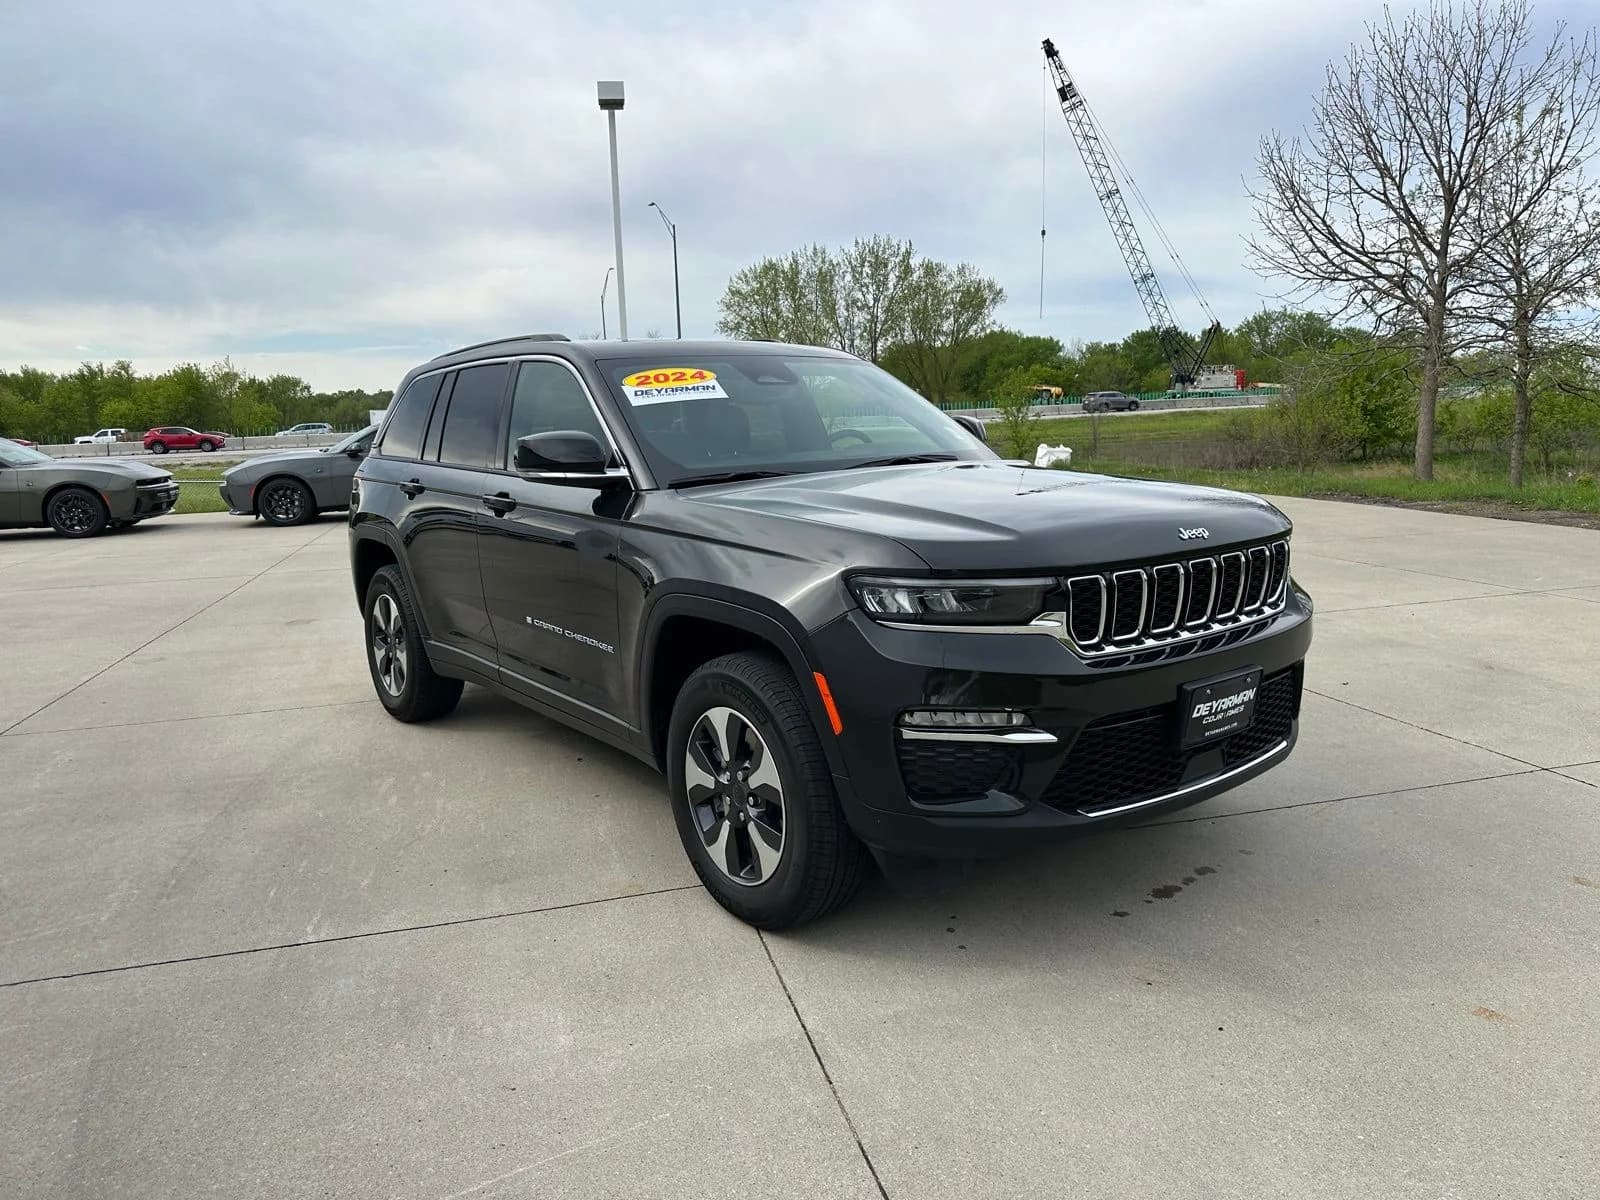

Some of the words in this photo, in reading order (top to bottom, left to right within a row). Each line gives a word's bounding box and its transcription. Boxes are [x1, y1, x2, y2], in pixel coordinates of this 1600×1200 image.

[635, 370, 707, 387] 2024
[634, 384, 716, 397] DEYARMAN
[1178, 527, 1209, 540] Jeep
[533, 619, 563, 635] GRAND
[564, 629, 615, 654] CHEROKEE
[1191, 687, 1257, 719] DEYARMAN
